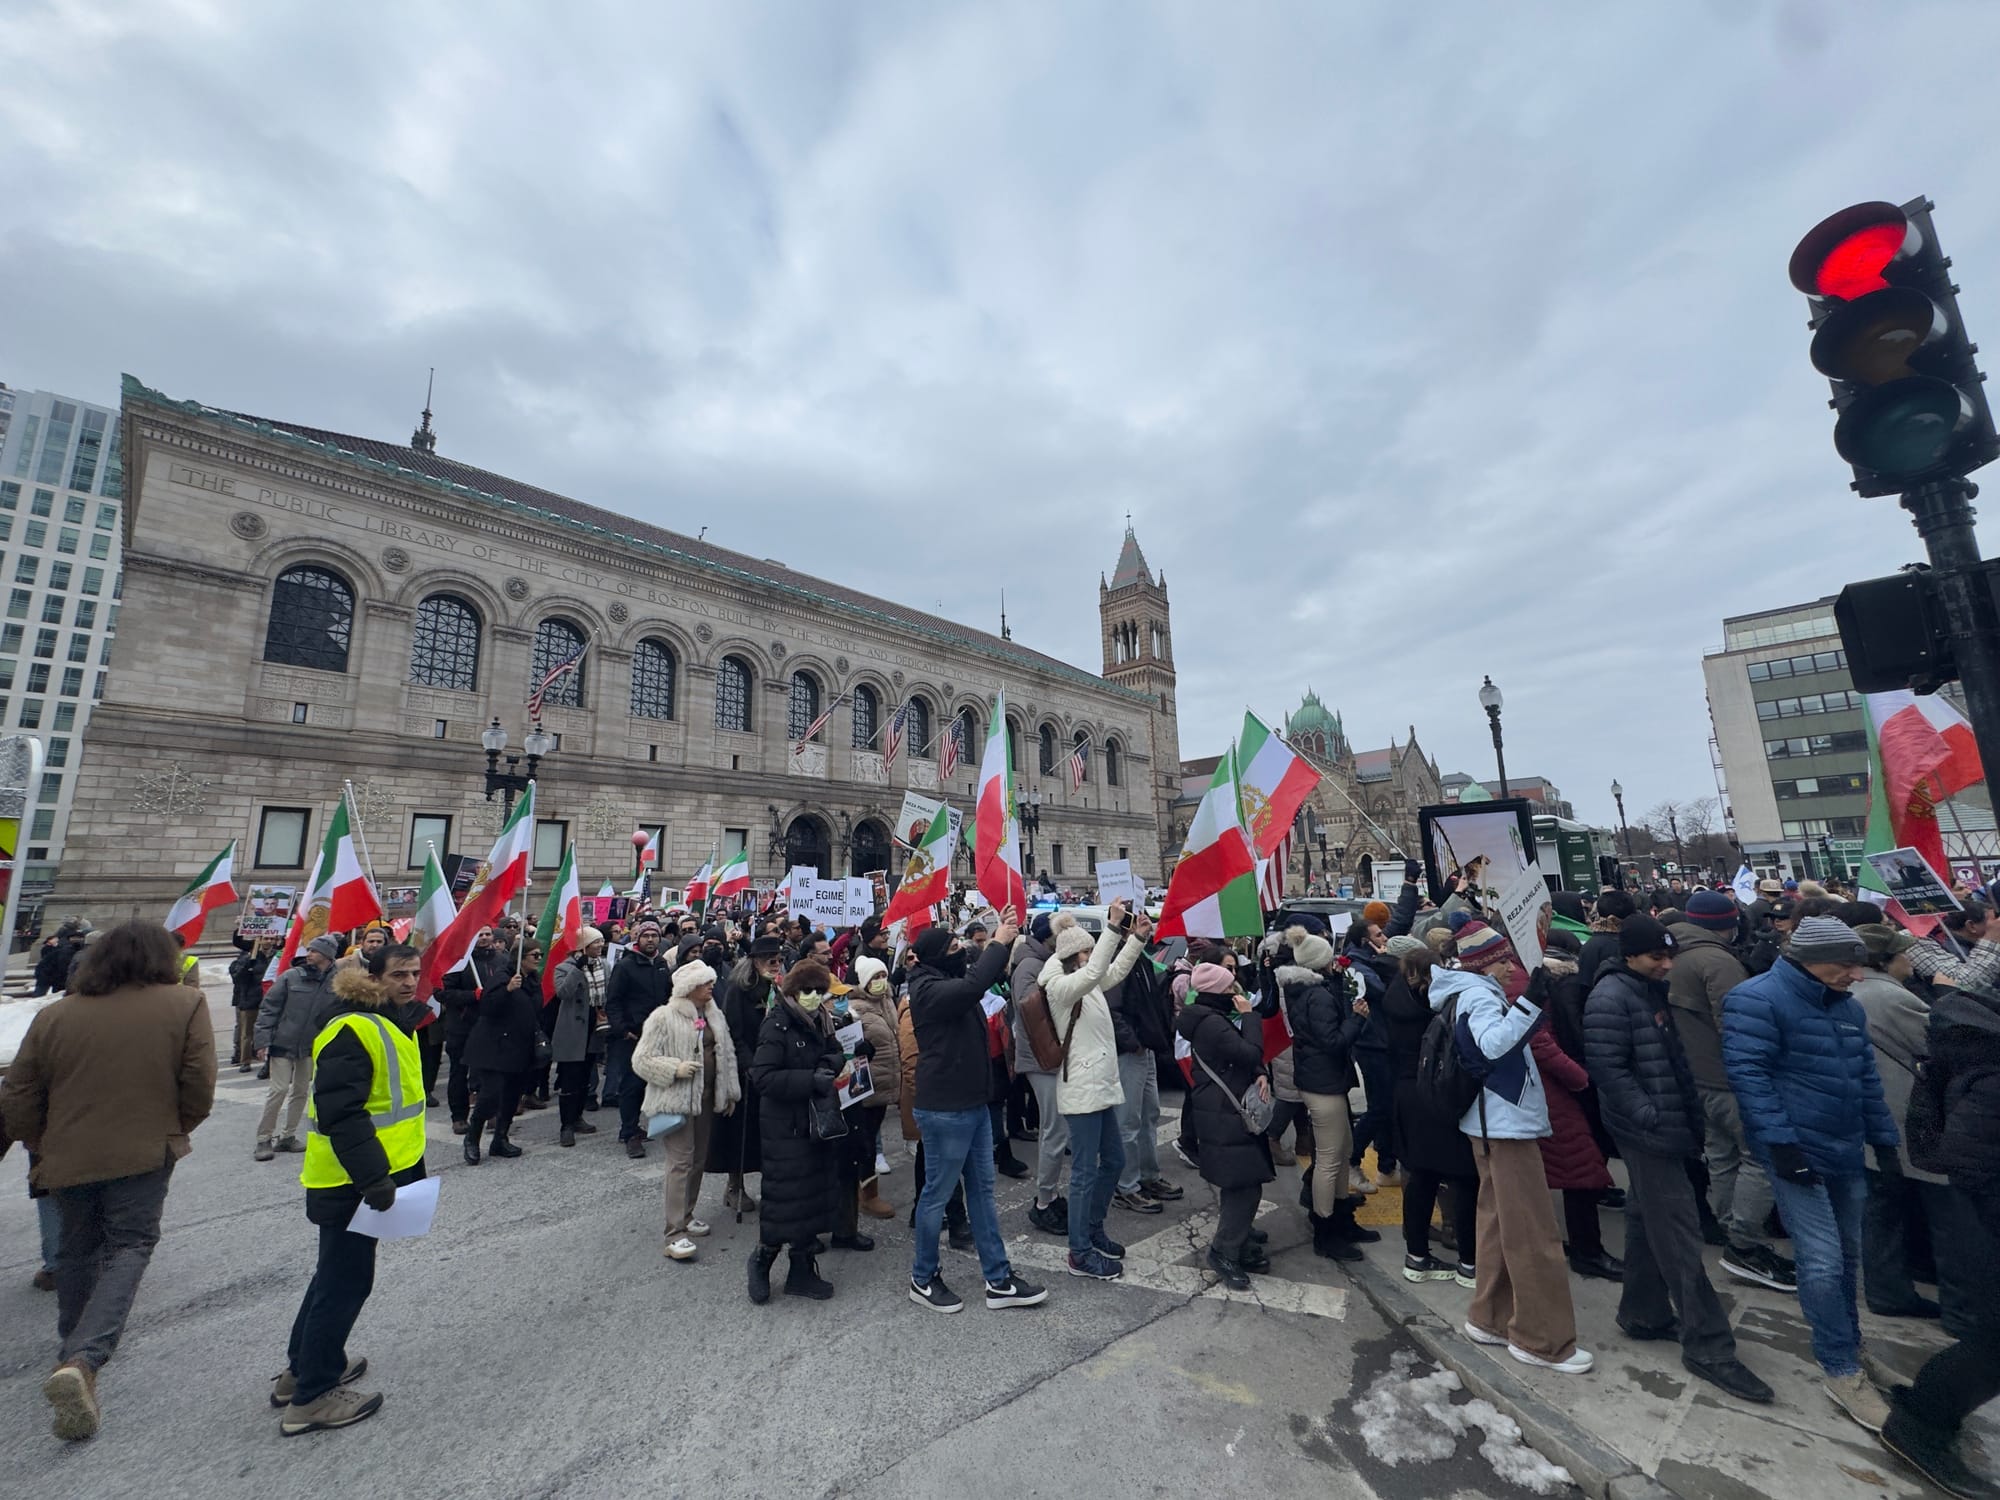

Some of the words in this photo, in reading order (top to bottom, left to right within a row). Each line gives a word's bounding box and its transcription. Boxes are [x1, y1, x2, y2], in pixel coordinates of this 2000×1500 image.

[182, 468, 236, 494] THE
[258, 488, 342, 521] PUBLIC
[365, 516, 459, 551] LIBRARY
[472, 545, 499, 561] OF
[515, 555, 551, 575] THE
[562, 568, 604, 587] CITY
[617, 582, 638, 596] OF
[648, 590, 709, 616] BOSTON
[718, 608, 753, 626] BUILT
[763, 618, 780, 632] BY
[788, 626, 812, 641] THE
[798, 877, 811, 888] WE
[815, 890, 844, 901] EGIME
[854, 887, 862, 896] IN
[792, 898, 814, 909] WANT
[1506, 904, 1523, 923] REZA
[1522, 880, 1543, 907] PAHLAVI
[849, 906, 865, 916] IRAN
